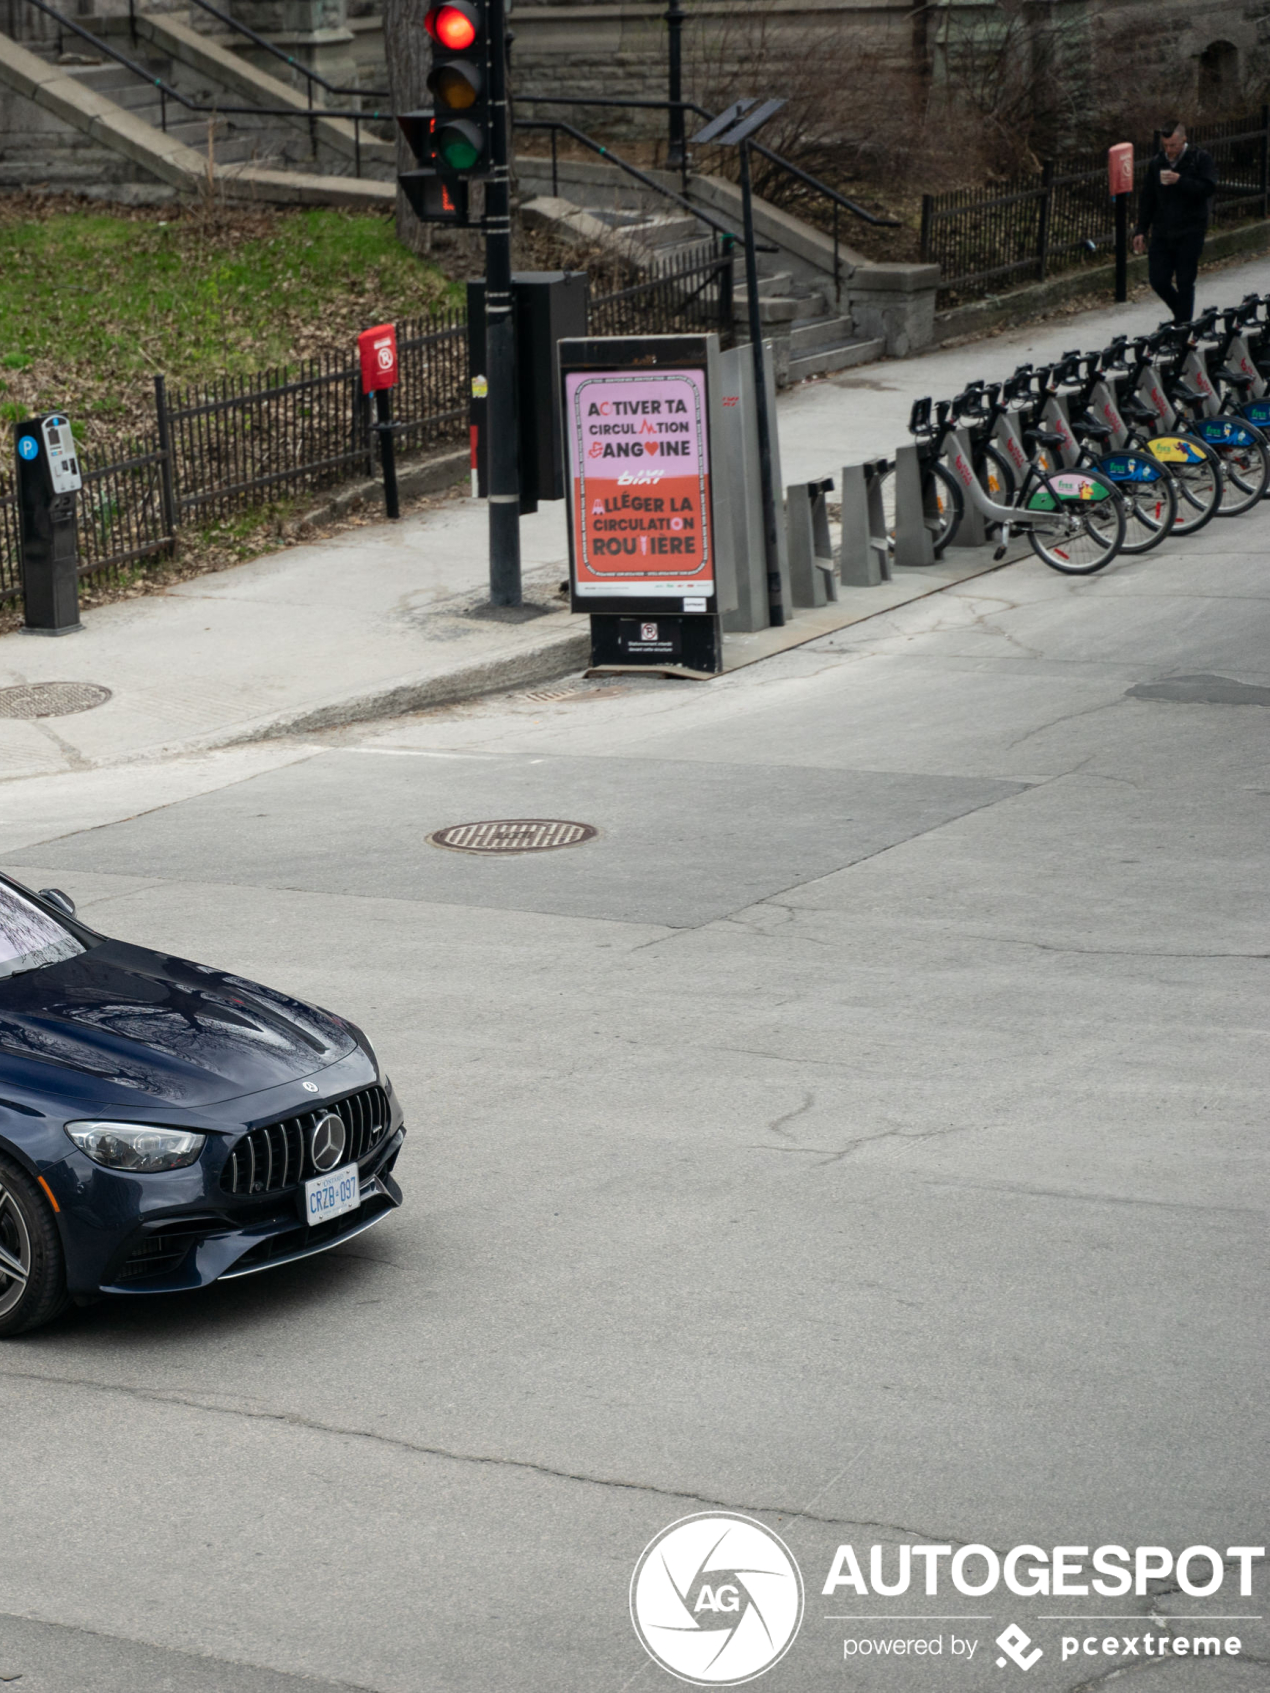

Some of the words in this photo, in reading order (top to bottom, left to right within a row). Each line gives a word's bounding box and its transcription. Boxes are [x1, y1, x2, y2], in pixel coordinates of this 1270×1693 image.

[588, 400, 662, 417] ACTIVER
[665, 399, 687, 414] TA
[592, 491, 664, 516] ALLÉGER
[670, 497, 693, 512] LA
[593, 517, 695, 532] CIRCULATION
